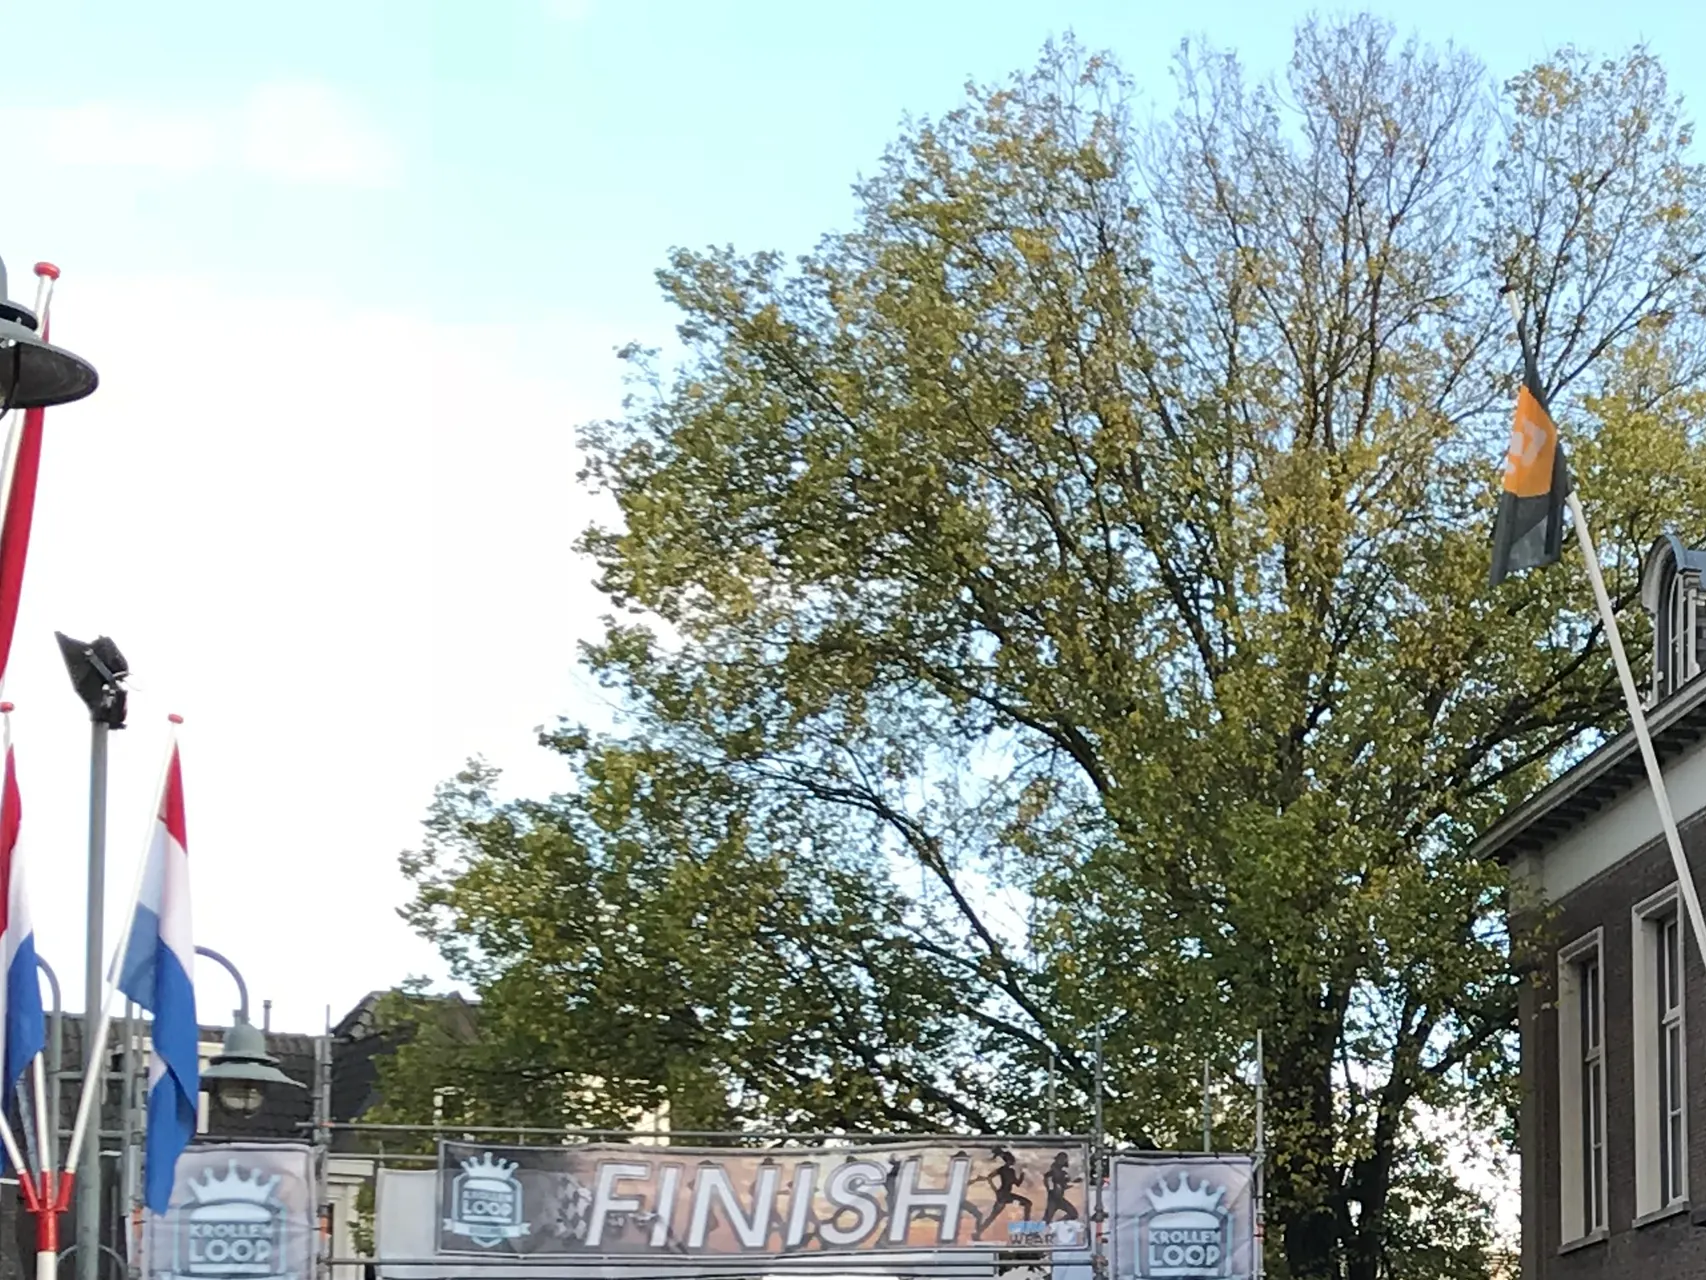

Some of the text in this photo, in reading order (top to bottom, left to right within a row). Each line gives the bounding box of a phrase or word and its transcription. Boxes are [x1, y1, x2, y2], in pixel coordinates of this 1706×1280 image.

[583, 1157, 972, 1249] FINISH
[189, 1223, 273, 1239] KROLLEN
[1149, 1230, 1222, 1244] KROLLEN
[189, 1240, 272, 1262] LOOP
[1149, 1244, 1220, 1266] LOOP
